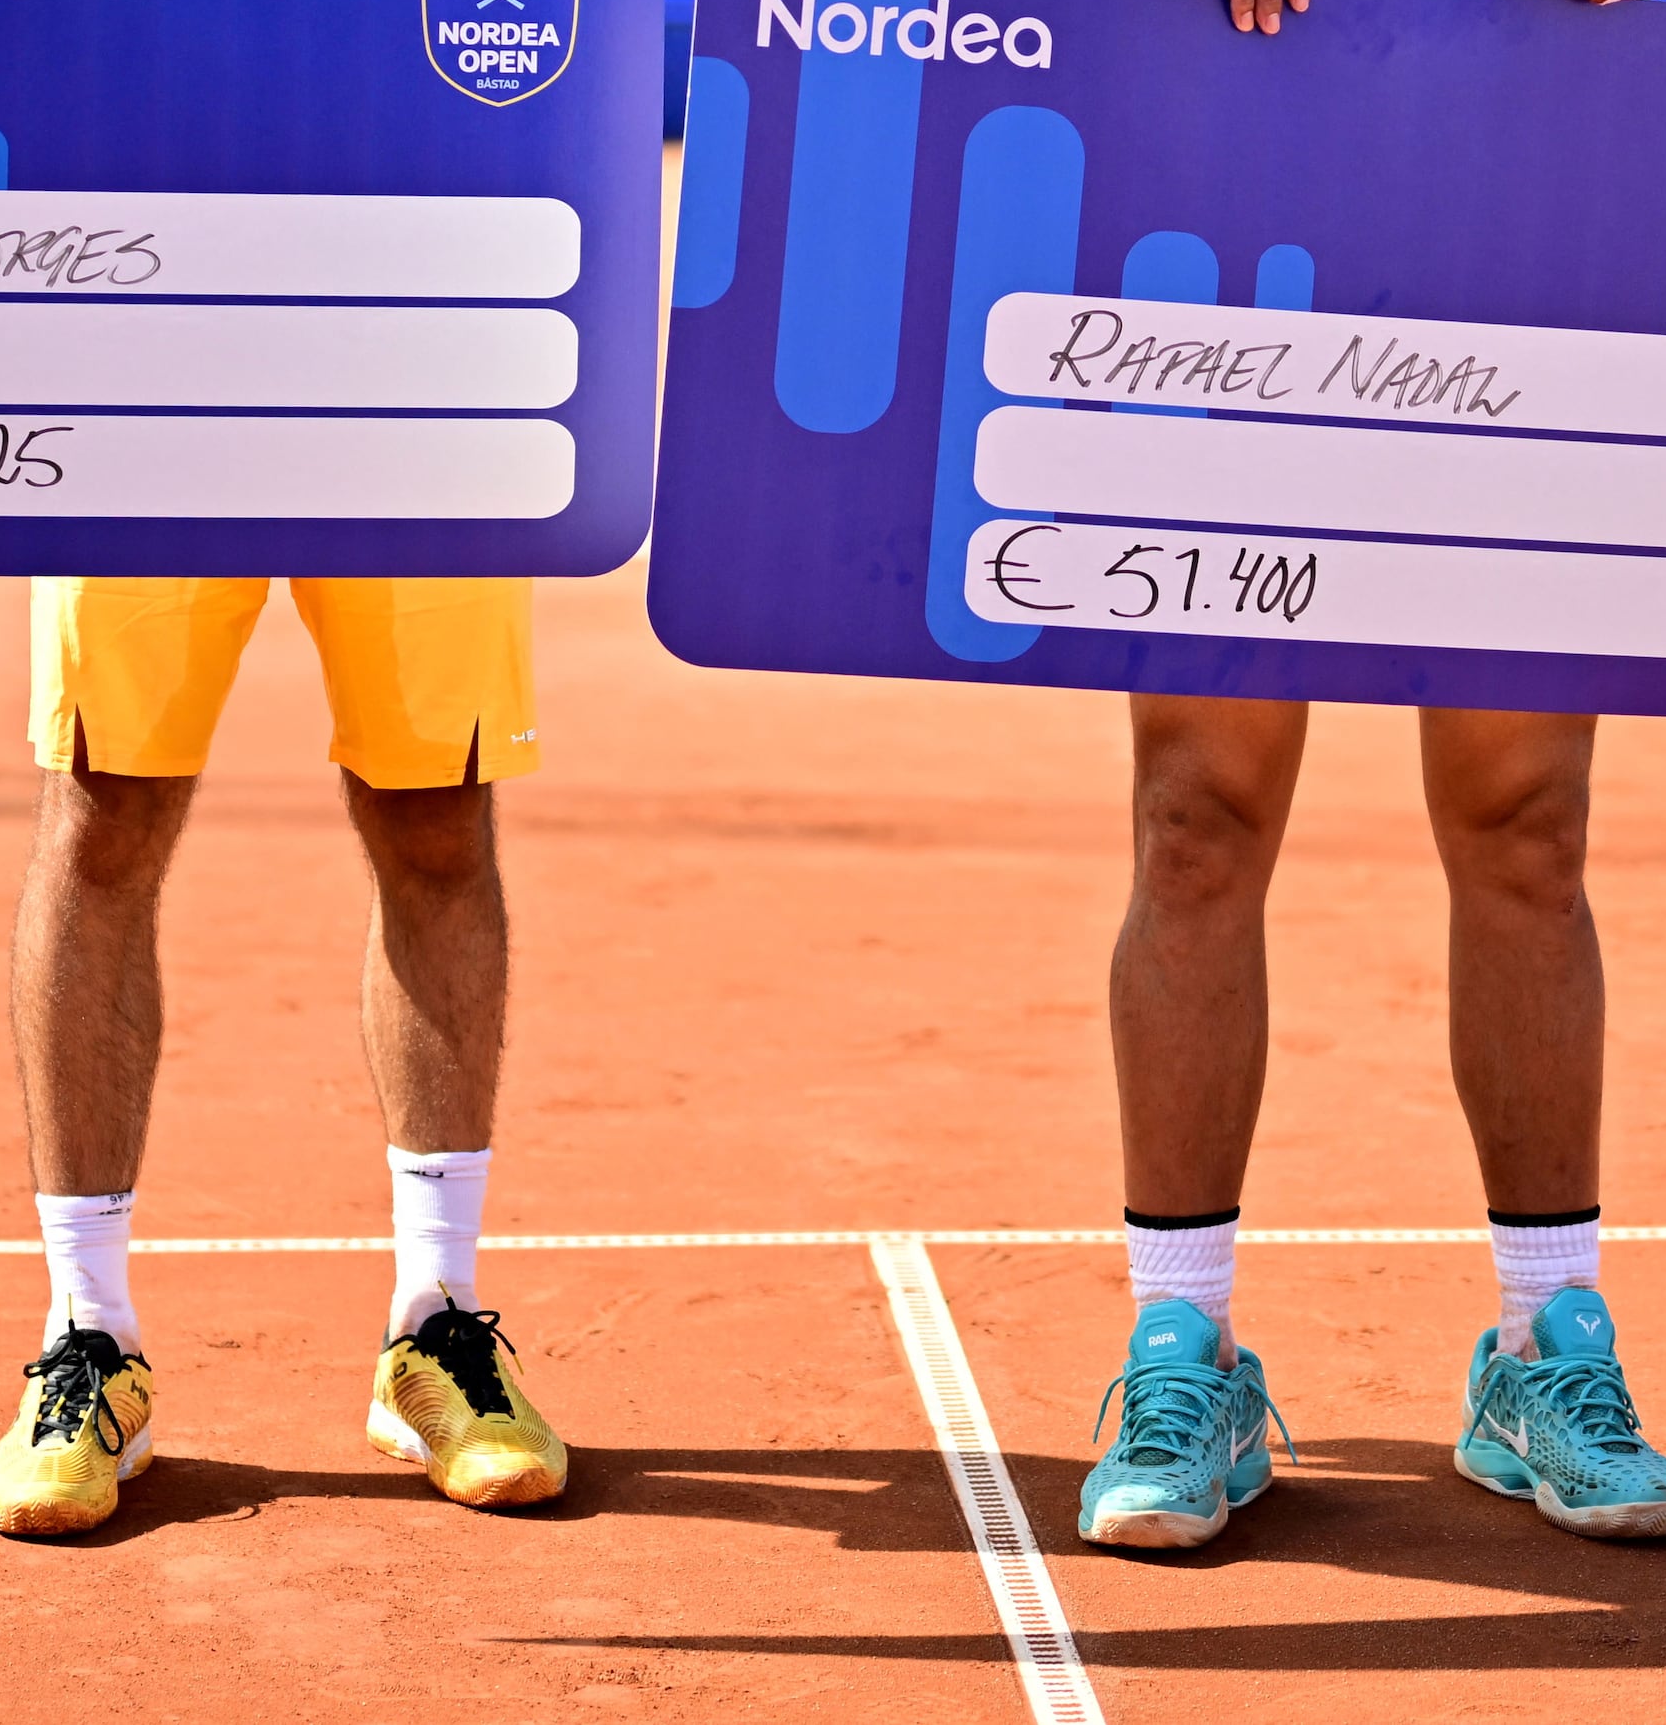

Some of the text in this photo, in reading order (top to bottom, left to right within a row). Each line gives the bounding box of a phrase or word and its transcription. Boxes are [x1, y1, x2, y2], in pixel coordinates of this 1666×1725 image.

[438, 21, 561, 47] NORDEA
[458, 50, 538, 74] OPEN
[476, 76, 520, 90] BÅSTAD
[1048, 308, 1522, 419] RAFAEL NADAL
[983, 525, 1076, 611] €
[509, 727, 538, 746] HE
[1148, 1331, 1178, 1348] RAFA
